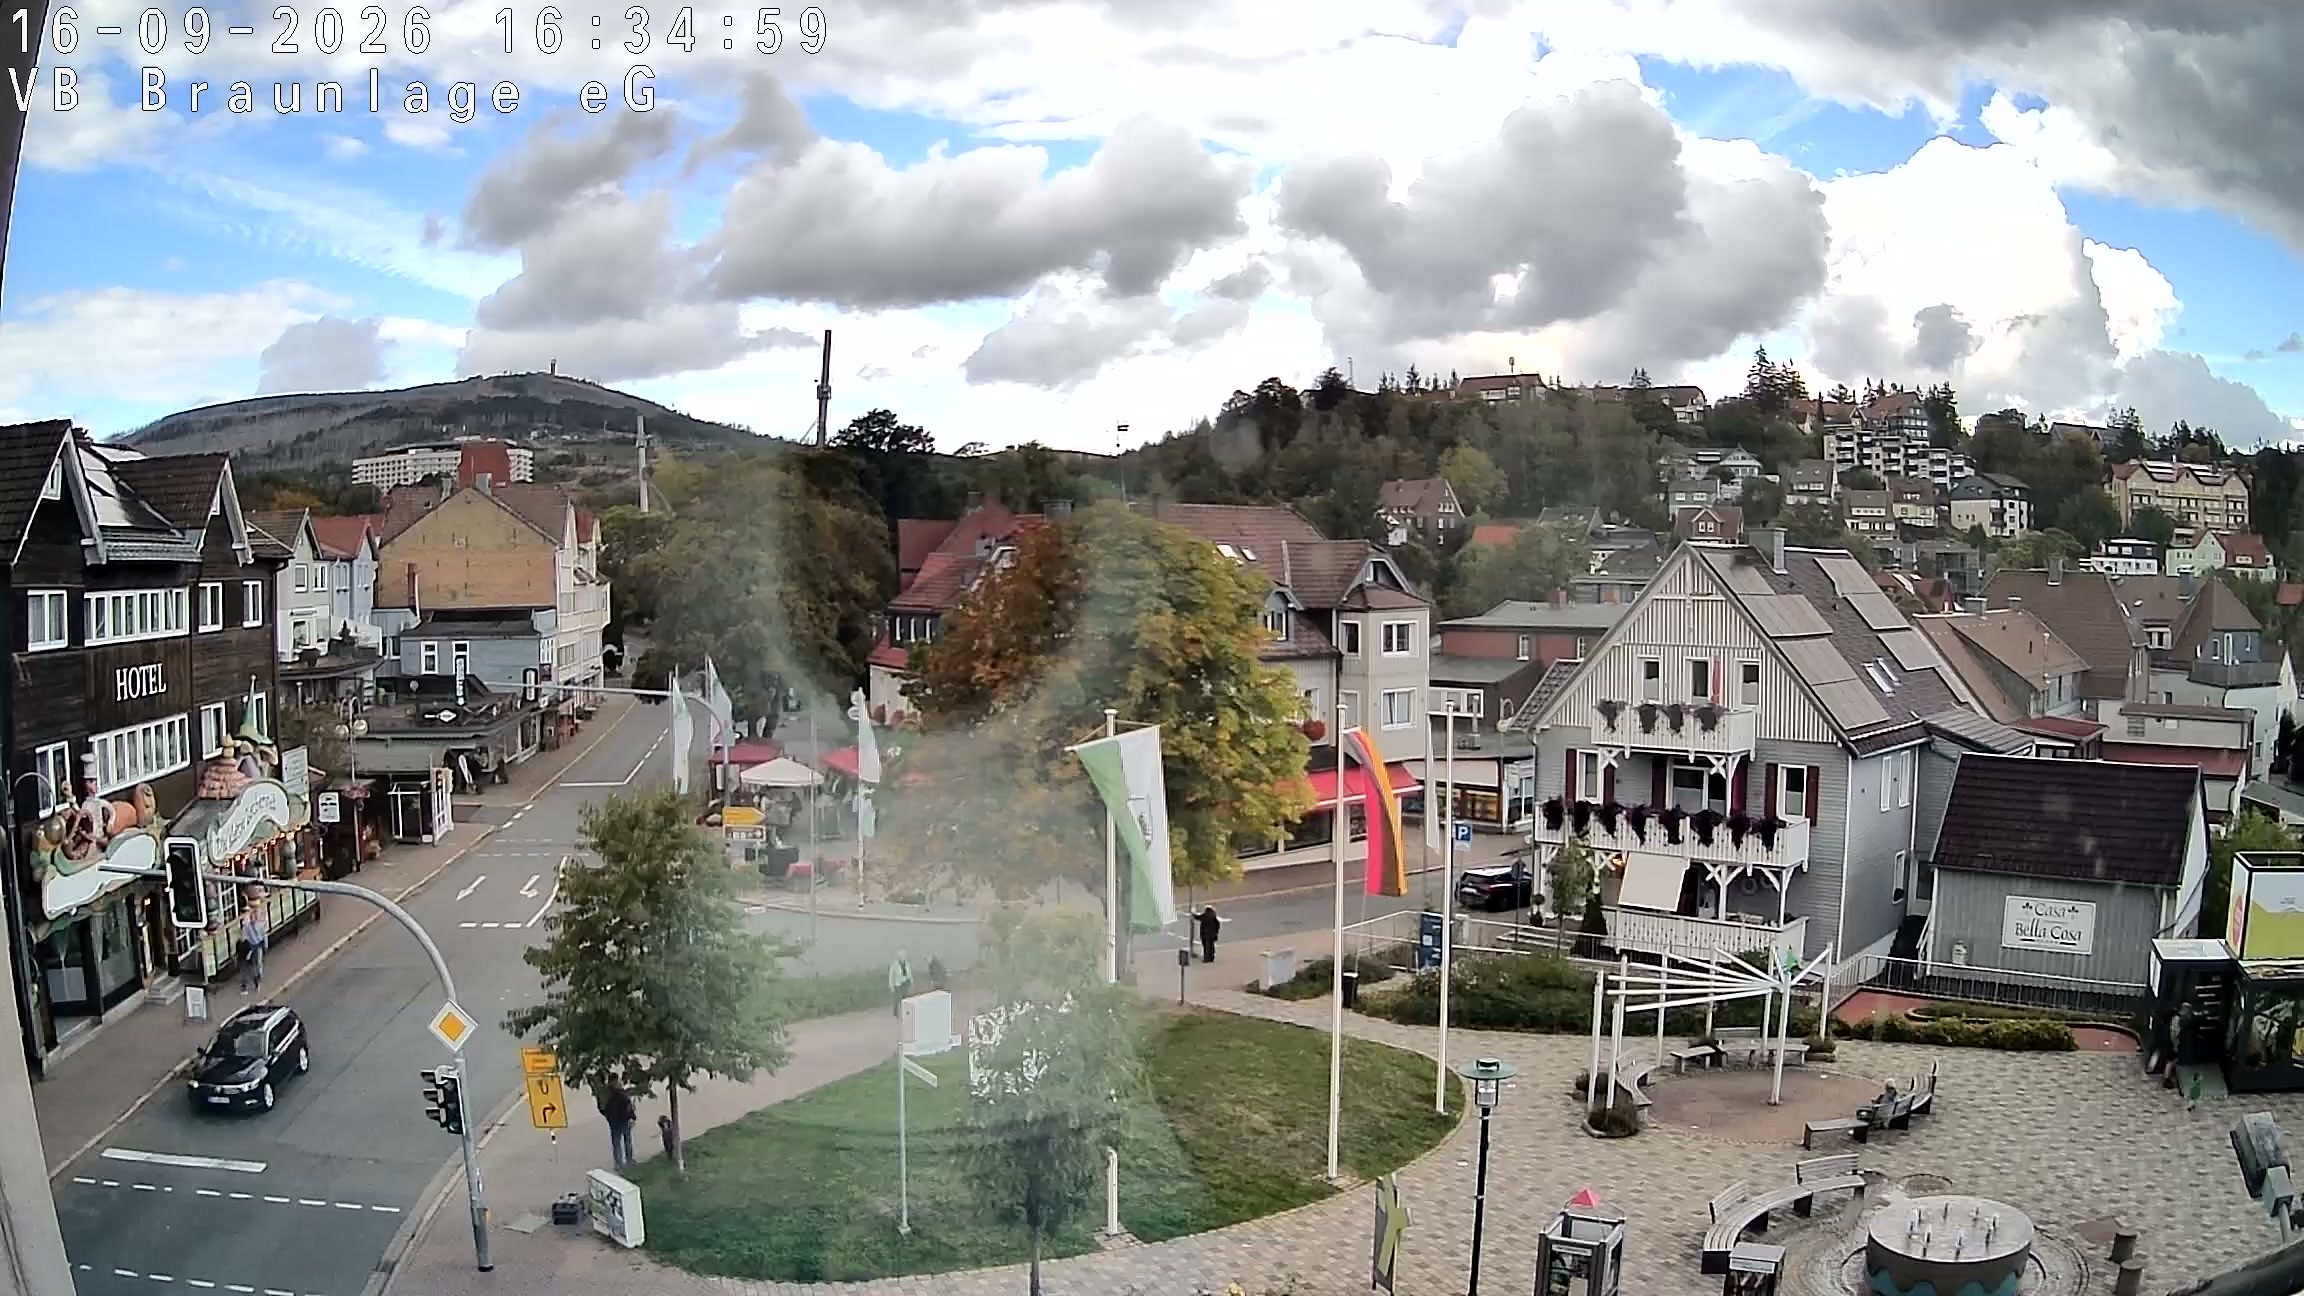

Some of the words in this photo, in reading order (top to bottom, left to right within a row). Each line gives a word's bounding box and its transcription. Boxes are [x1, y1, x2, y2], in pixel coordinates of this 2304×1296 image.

[115, 662, 167, 702] HOTEL
[1458, 825, 1469, 840] P
[2015, 917, 2047, 938] Bella
